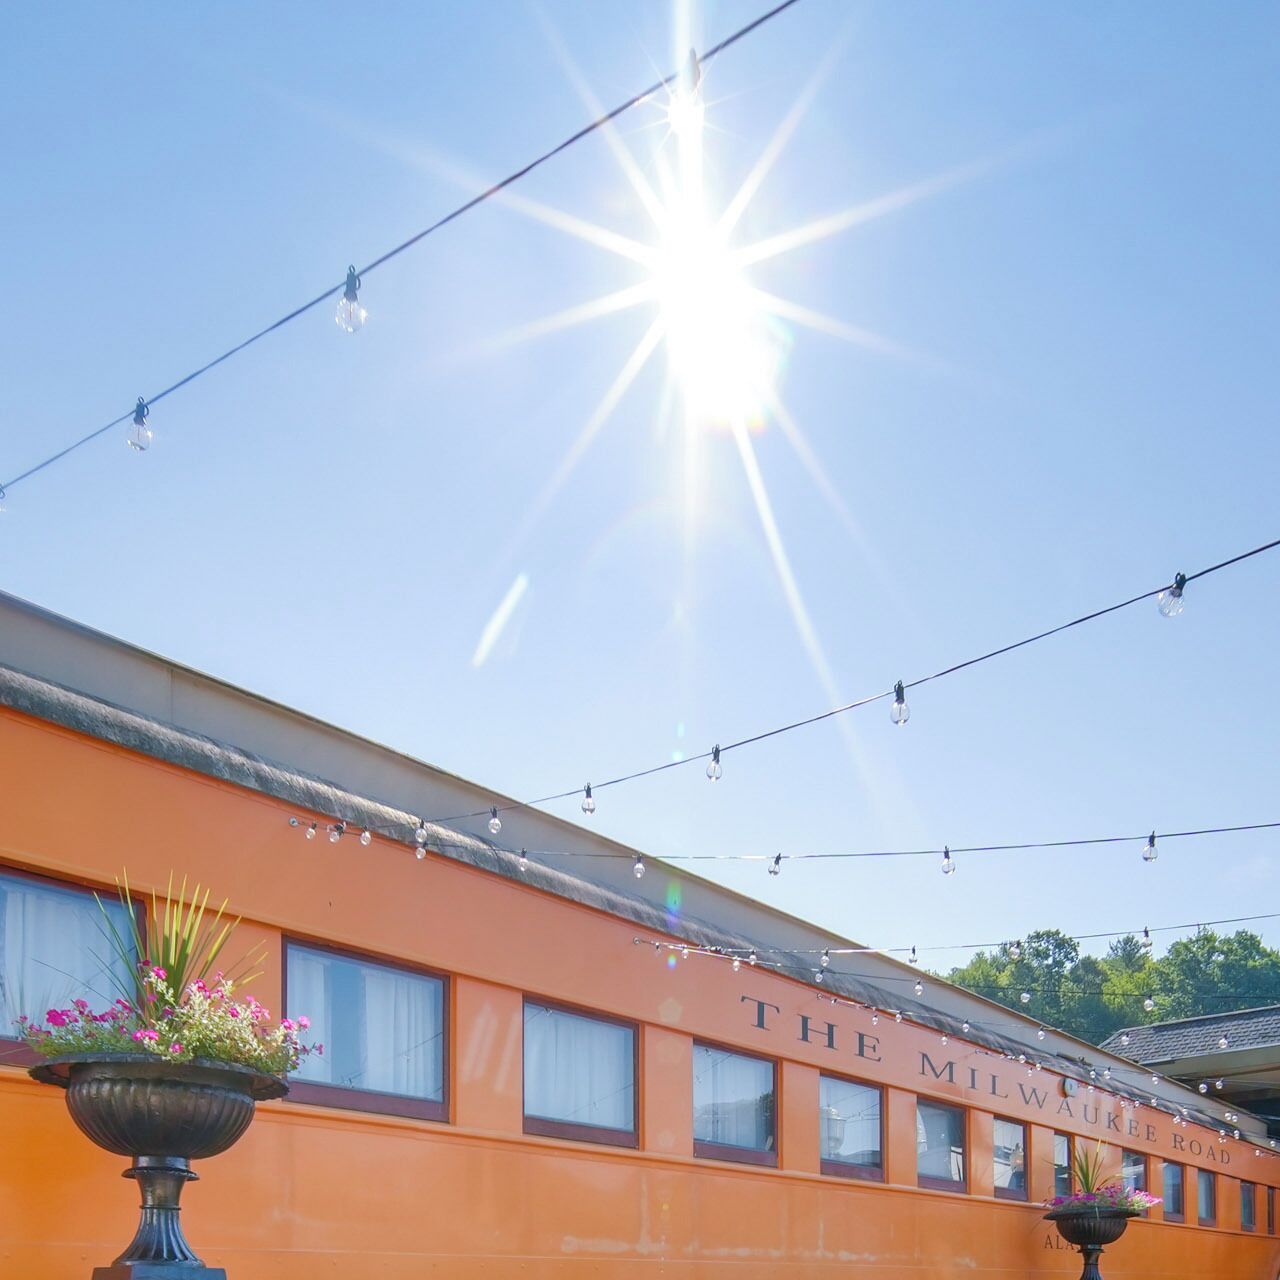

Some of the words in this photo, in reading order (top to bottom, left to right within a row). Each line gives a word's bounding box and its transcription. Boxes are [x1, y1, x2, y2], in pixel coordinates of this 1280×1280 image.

[740, 995, 882, 1062] THE
[918, 1051, 1157, 1143] MILWAUKEE
[1171, 1132, 1231, 1165] ROAD
